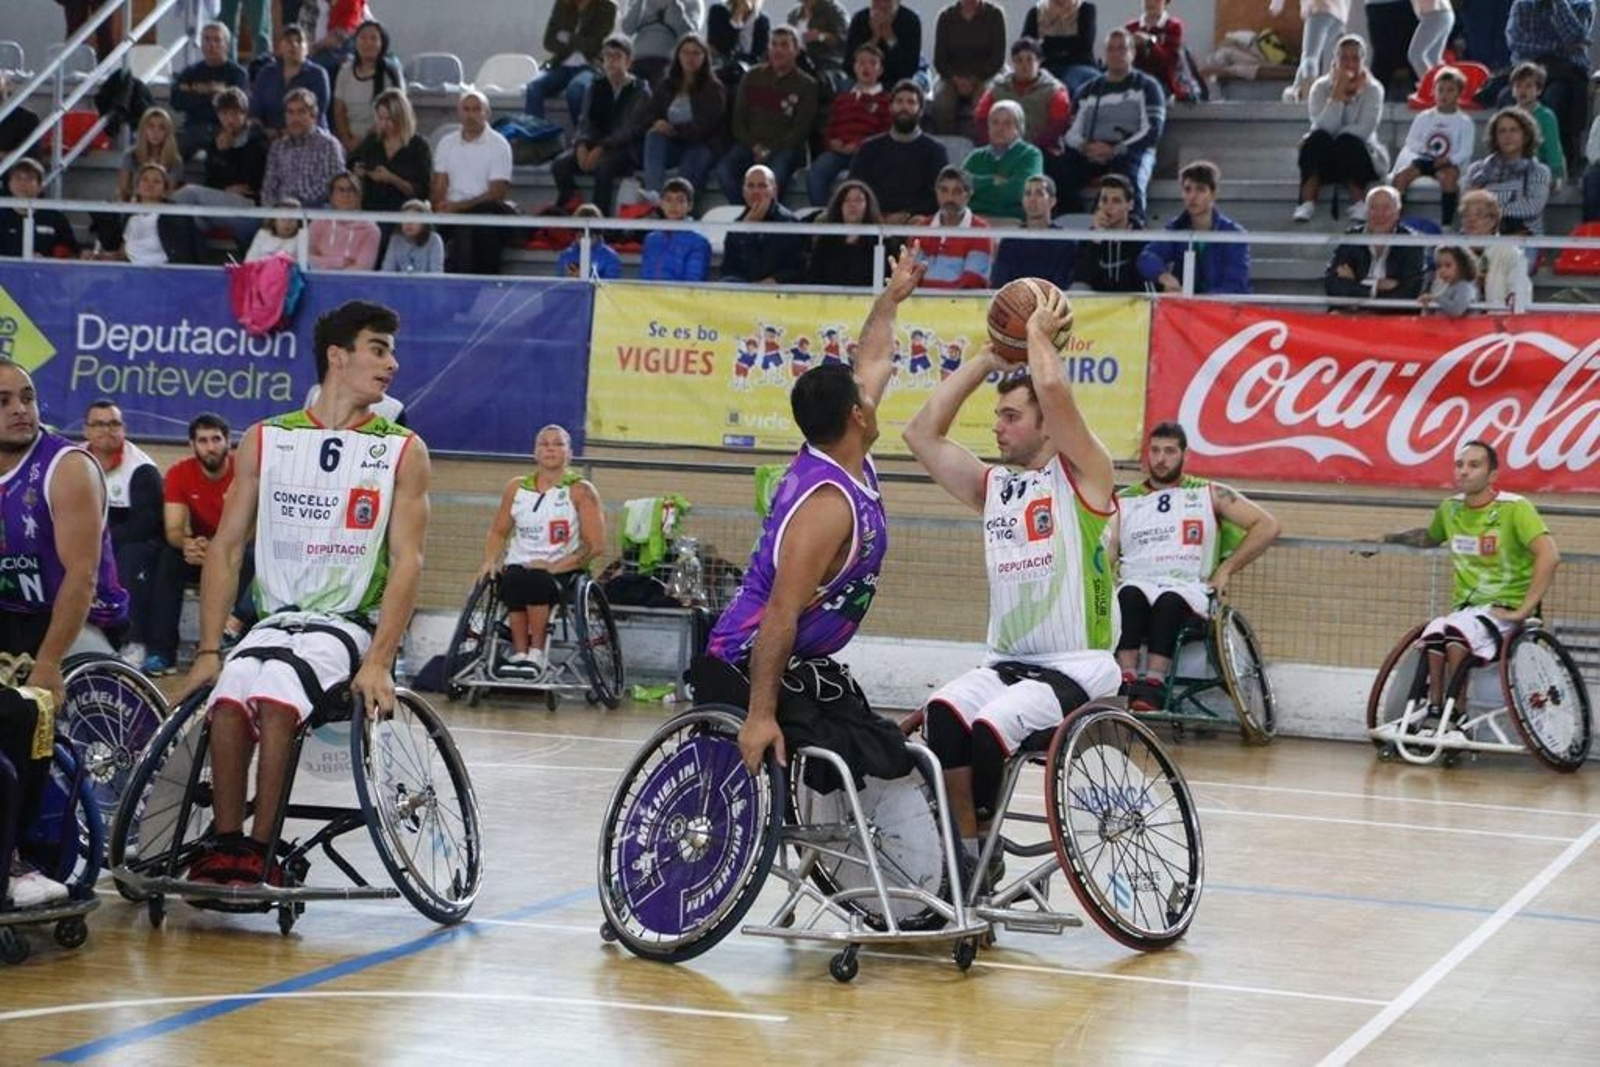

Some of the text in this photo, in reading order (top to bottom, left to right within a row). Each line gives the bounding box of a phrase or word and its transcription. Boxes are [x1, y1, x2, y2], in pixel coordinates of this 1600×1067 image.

[649, 321, 718, 342] Se es bo
[616, 342, 715, 376] VIGUÉS
[70, 354, 293, 401] Pontevedra
[1178, 320, 1600, 470] Coca-Cola
[319, 437, 343, 472] 6
[273, 491, 339, 507] CONCELLO
[281, 505, 331, 520] DE VIGO
[1157, 493, 1171, 513] 8
[636, 761, 696, 847] MICHELIN
[686, 824, 744, 914] MICHELIN
